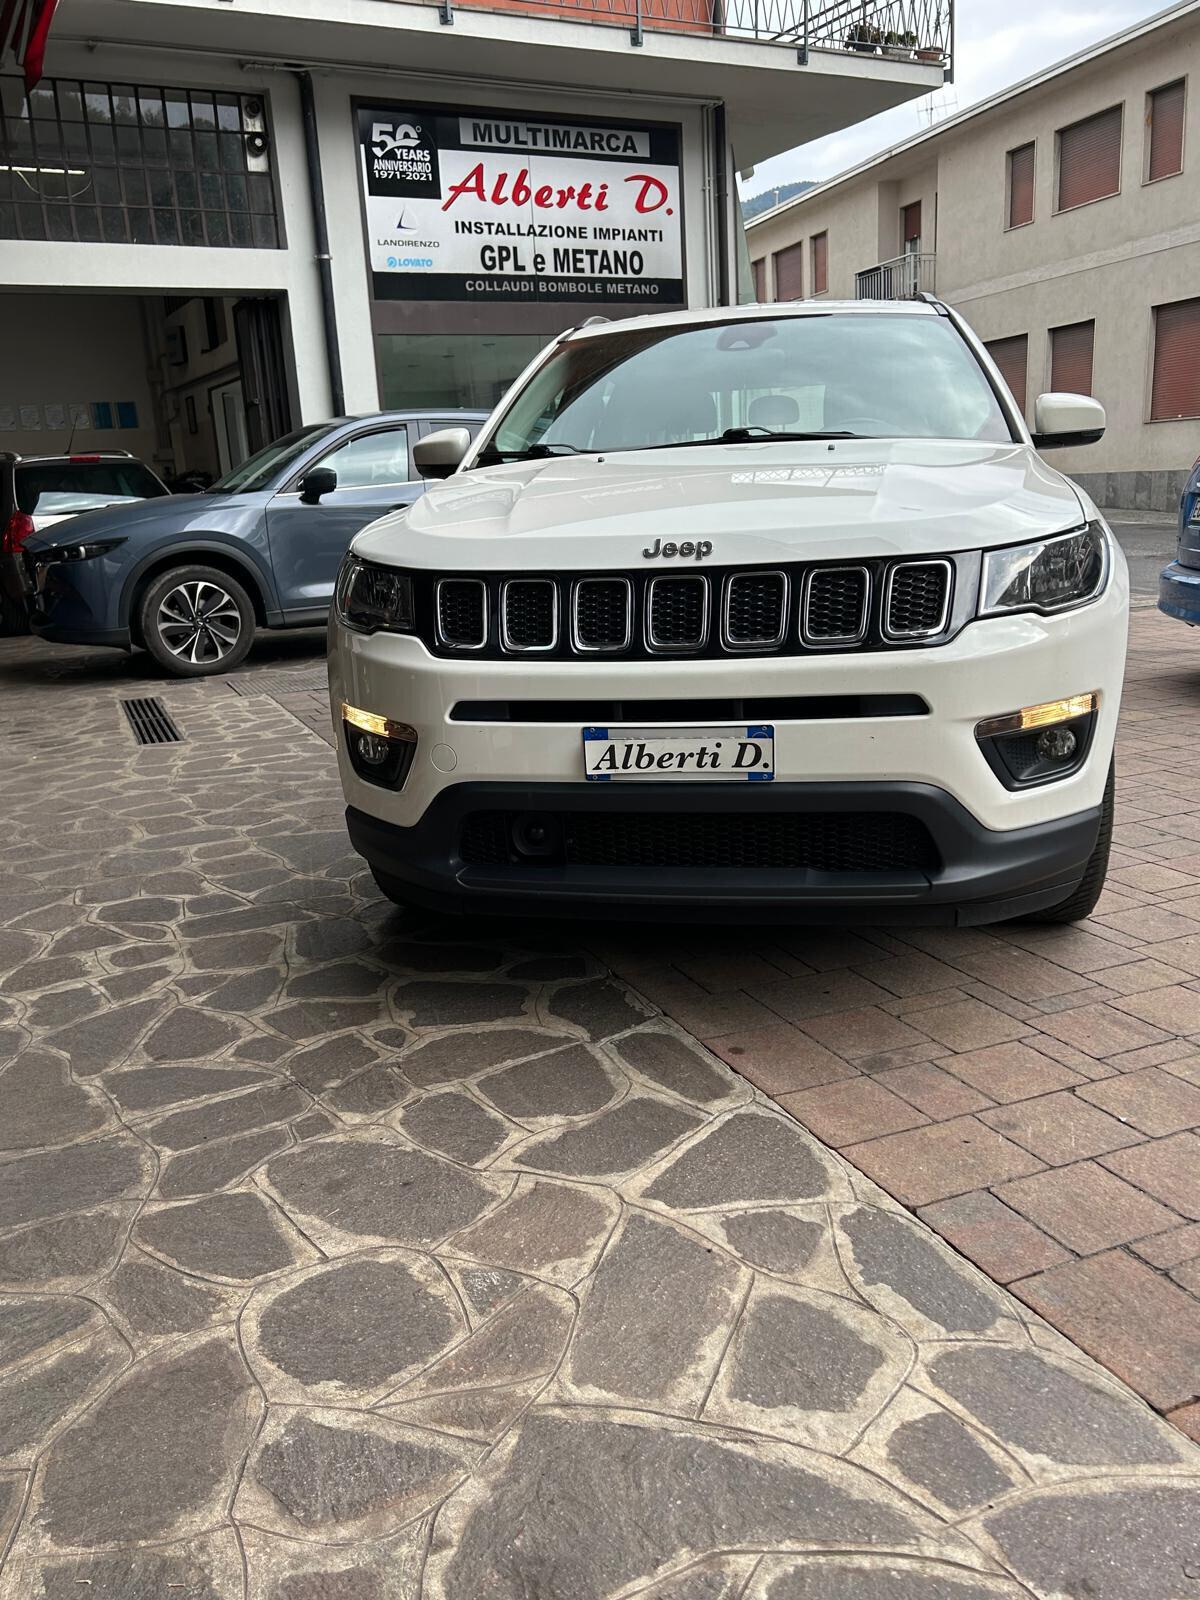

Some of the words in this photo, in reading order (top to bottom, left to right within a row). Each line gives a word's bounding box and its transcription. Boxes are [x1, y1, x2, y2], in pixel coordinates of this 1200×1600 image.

[472, 122, 638, 154] MULTIMARCA
[394, 148, 430, 162] YEARS
[373, 158, 432, 174] ANNIVERSARIO
[373, 170, 433, 181] 1971-2021
[441, 162, 609, 212] Alberti
[624, 174, 674, 216] D.
[454, 220, 588, 239] INSTALLAZIONE
[593, 227, 664, 242] IMPIANTI
[377, 239, 440, 248] LANDIRENZO
[398, 257, 433, 268] LOVATO
[480, 244, 526, 272] GPL
[533, 253, 546, 273] e
[553, 247, 644, 276] METANO
[465, 279, 535, 293] COLLAUDI
[538, 281, 603, 294] BOMBOLE
[606, 283, 660, 295] METANO
[642, 538, 713, 561] Jeep
[592, 742, 722, 771] Alberti
[732, 742, 770, 769] D.
